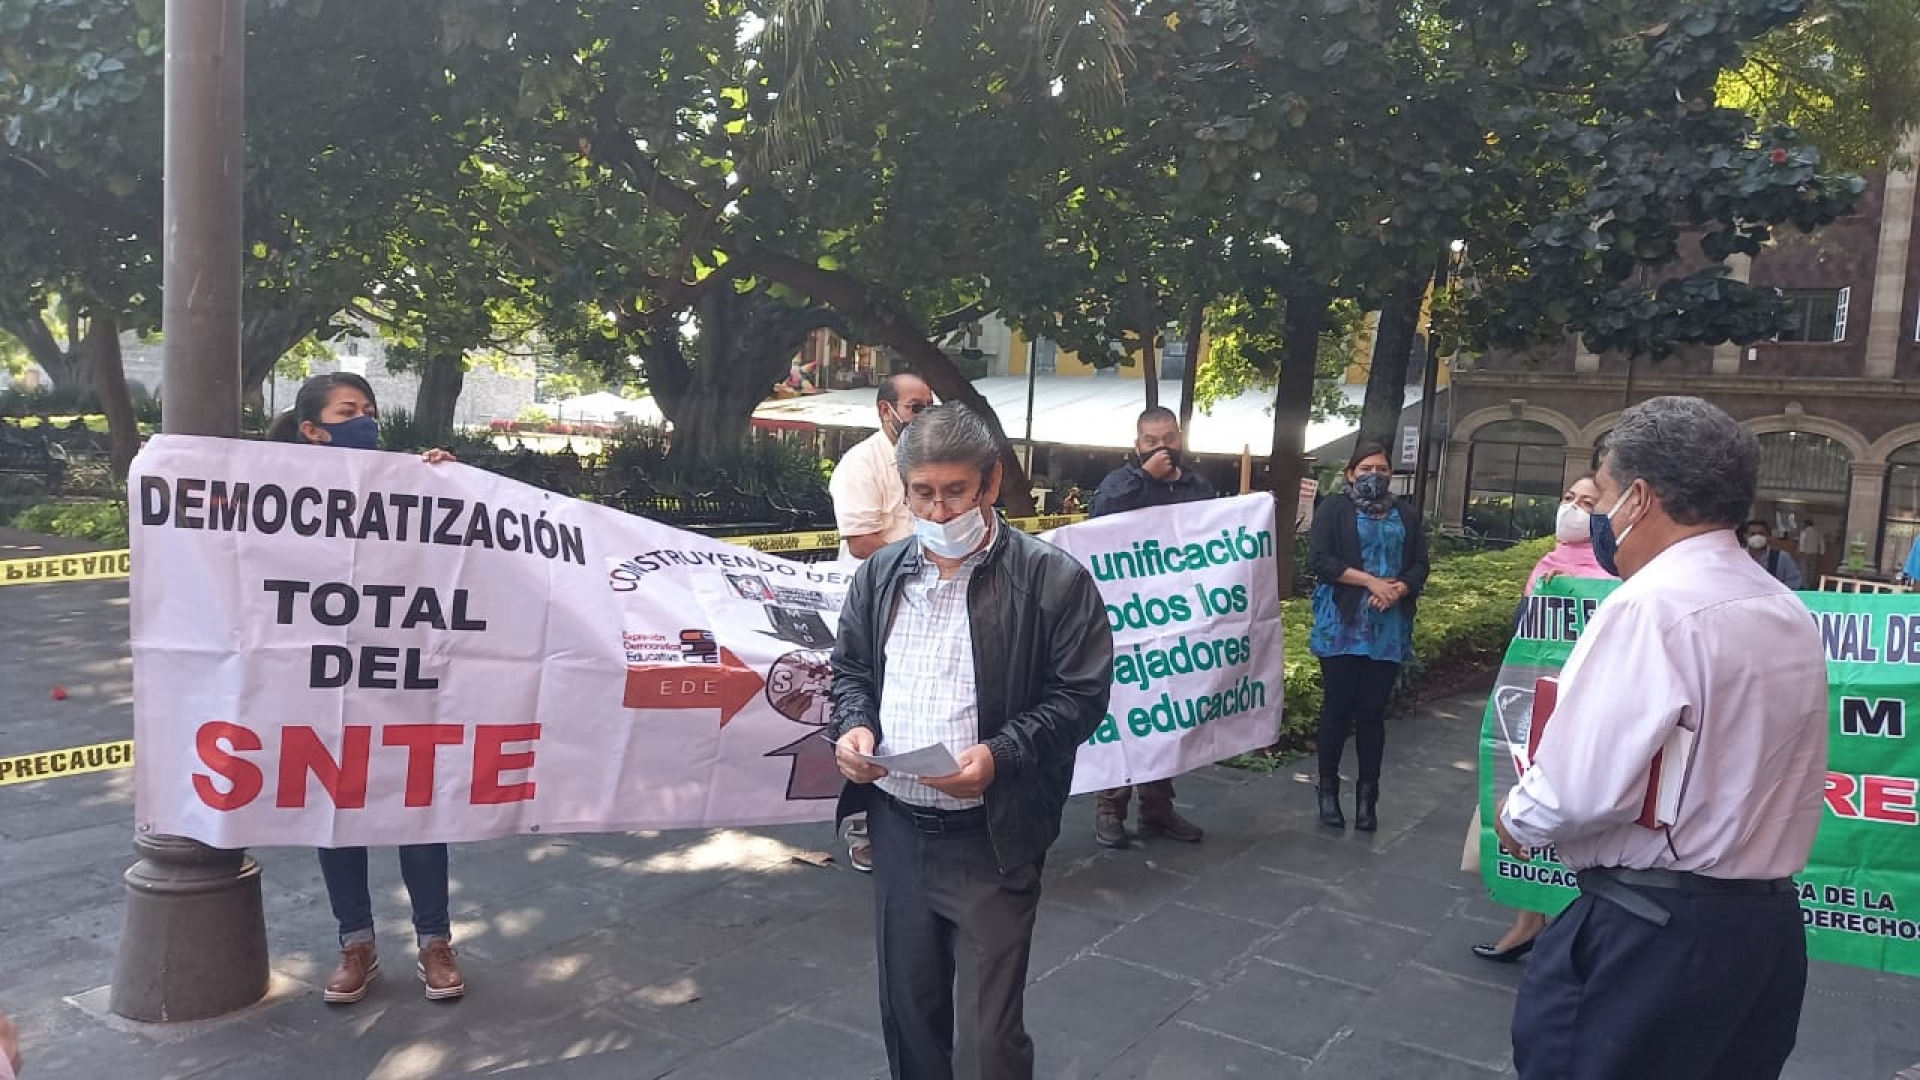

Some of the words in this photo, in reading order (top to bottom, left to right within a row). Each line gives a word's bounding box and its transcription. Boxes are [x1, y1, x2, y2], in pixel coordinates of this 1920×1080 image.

[140, 475, 587, 565] DEMOCRATIZACIÓN
[609, 549, 796, 592] CONSTRUYENDO
[1091, 526, 1272, 582] unificación
[263, 579, 487, 631] TOTAL
[1103, 592, 1192, 632] odos
[1195, 583, 1248, 617] los
[309, 644, 440, 689] DEL
[1109, 635, 1250, 690] ajadores
[1128, 676, 1266, 738] educación
[1840, 696, 1905, 738] M
[192, 721, 542, 812] SNTE
[1825, 886, 1857, 905] DE
[1863, 890, 1896, 912] LA
